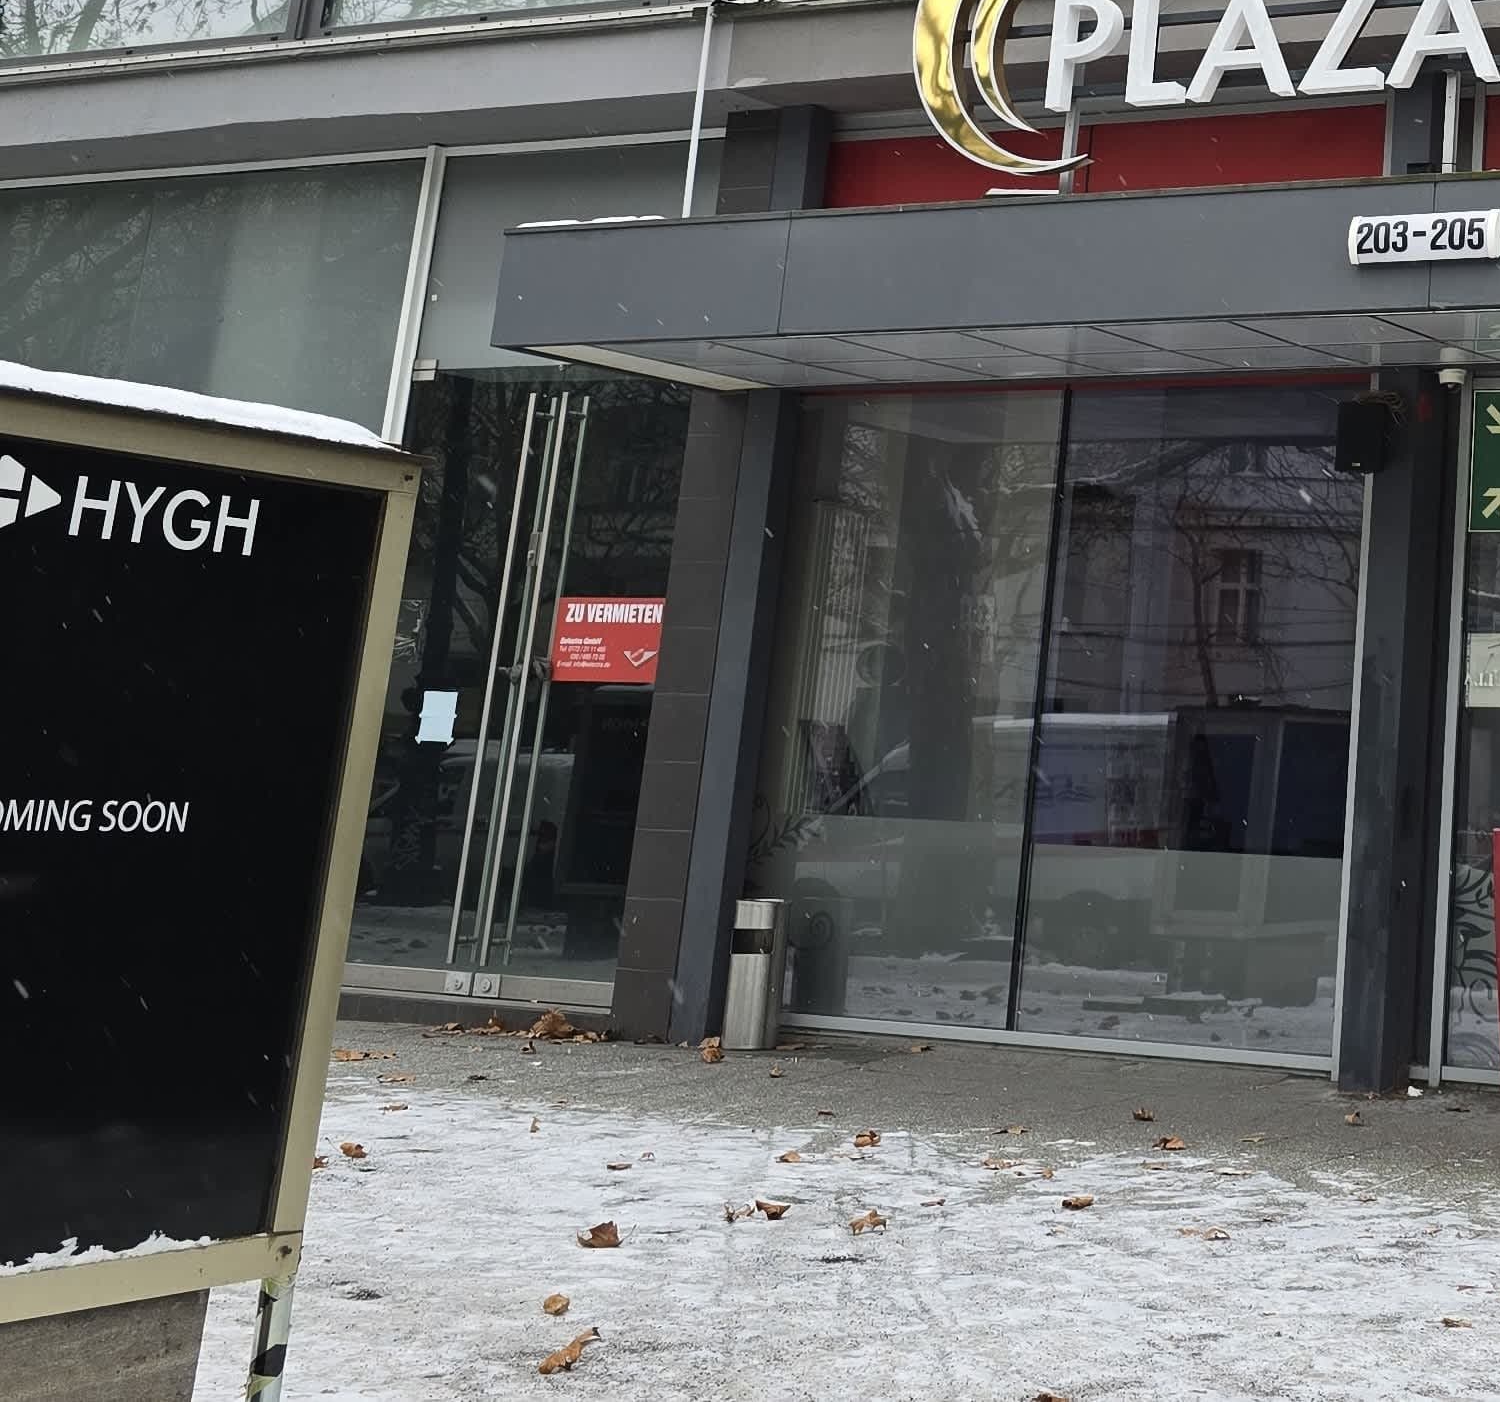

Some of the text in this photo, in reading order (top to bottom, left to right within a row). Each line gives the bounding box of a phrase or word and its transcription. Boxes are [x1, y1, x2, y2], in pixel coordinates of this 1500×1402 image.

[1356, 217, 1486, 255] 203-205
[68, 475, 260, 556] HYGH
[565, 603, 664, 624] ZU VERMIETEN
[0, 799, 190, 833] MING SOON
